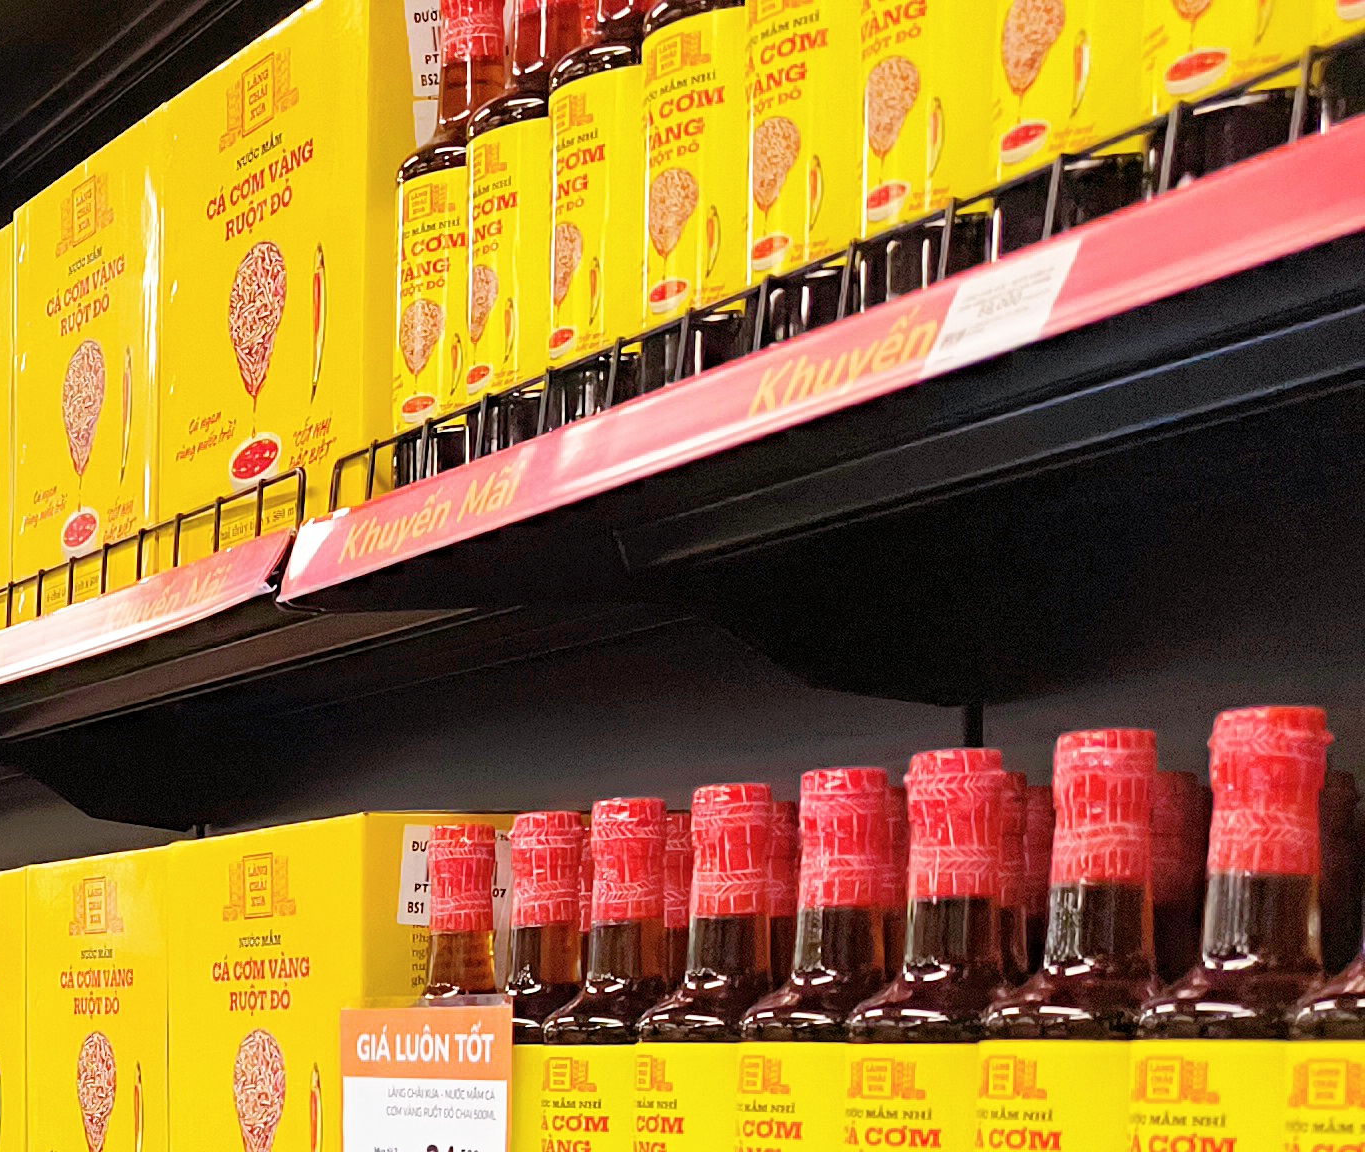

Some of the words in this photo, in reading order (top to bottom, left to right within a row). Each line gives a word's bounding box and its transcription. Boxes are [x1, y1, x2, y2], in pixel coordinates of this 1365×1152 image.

[759, 27, 829, 66] CƠM
[658, 84, 726, 120] CƠM
[775, 87, 802, 106] ĐỎ
[676, 138, 700, 158] ĐỎ
[206, 185, 227, 221] CÁ
[229, 167, 266, 208] CƠM
[268, 136, 314, 184] VÀNG
[224, 200, 269, 243] RUỘT
[269, 177, 293, 217] ĐỎ
[410, 231, 467, 257] CƠM
[46, 287, 62, 319] CÁ
[63, 275, 90, 308] CƠM
[92, 253, 126, 291] VÀNG
[60, 302, 92, 338] RUỘT
[92, 286, 111, 319] ĐỎ
[748, 303, 939, 417] Khuyến
[338, 490, 450, 567] Khuyến
[455, 462, 528, 535] Mãi
[407, 901, 425, 914] BS1
[59, 965, 75, 989] CÁ
[76, 967, 101, 988] CƠM
[103, 964, 134, 988] VÀNG
[212, 954, 232, 982] CÁ
[232, 955, 266, 981] CƠM
[268, 952, 311, 980] VÀNG
[73, 991, 102, 1019] RUỘT
[103, 990, 120, 1016] ĐỎ
[229, 983, 267, 1017] RUỘT
[269, 982, 291, 1011] ĐỎ
[356, 1024, 391, 1062] GIÁ
[395, 1024, 450, 1063] LUÔN
[454, 1020, 495, 1064] TỐT
[551, 1113, 610, 1133] CƠM
[635, 1114, 685, 1135] CƠM
[742, 1119, 803, 1140] CƠM
[864, 1125, 942, 1149] CƠM
[988, 1126, 1062, 1151] CƠM
